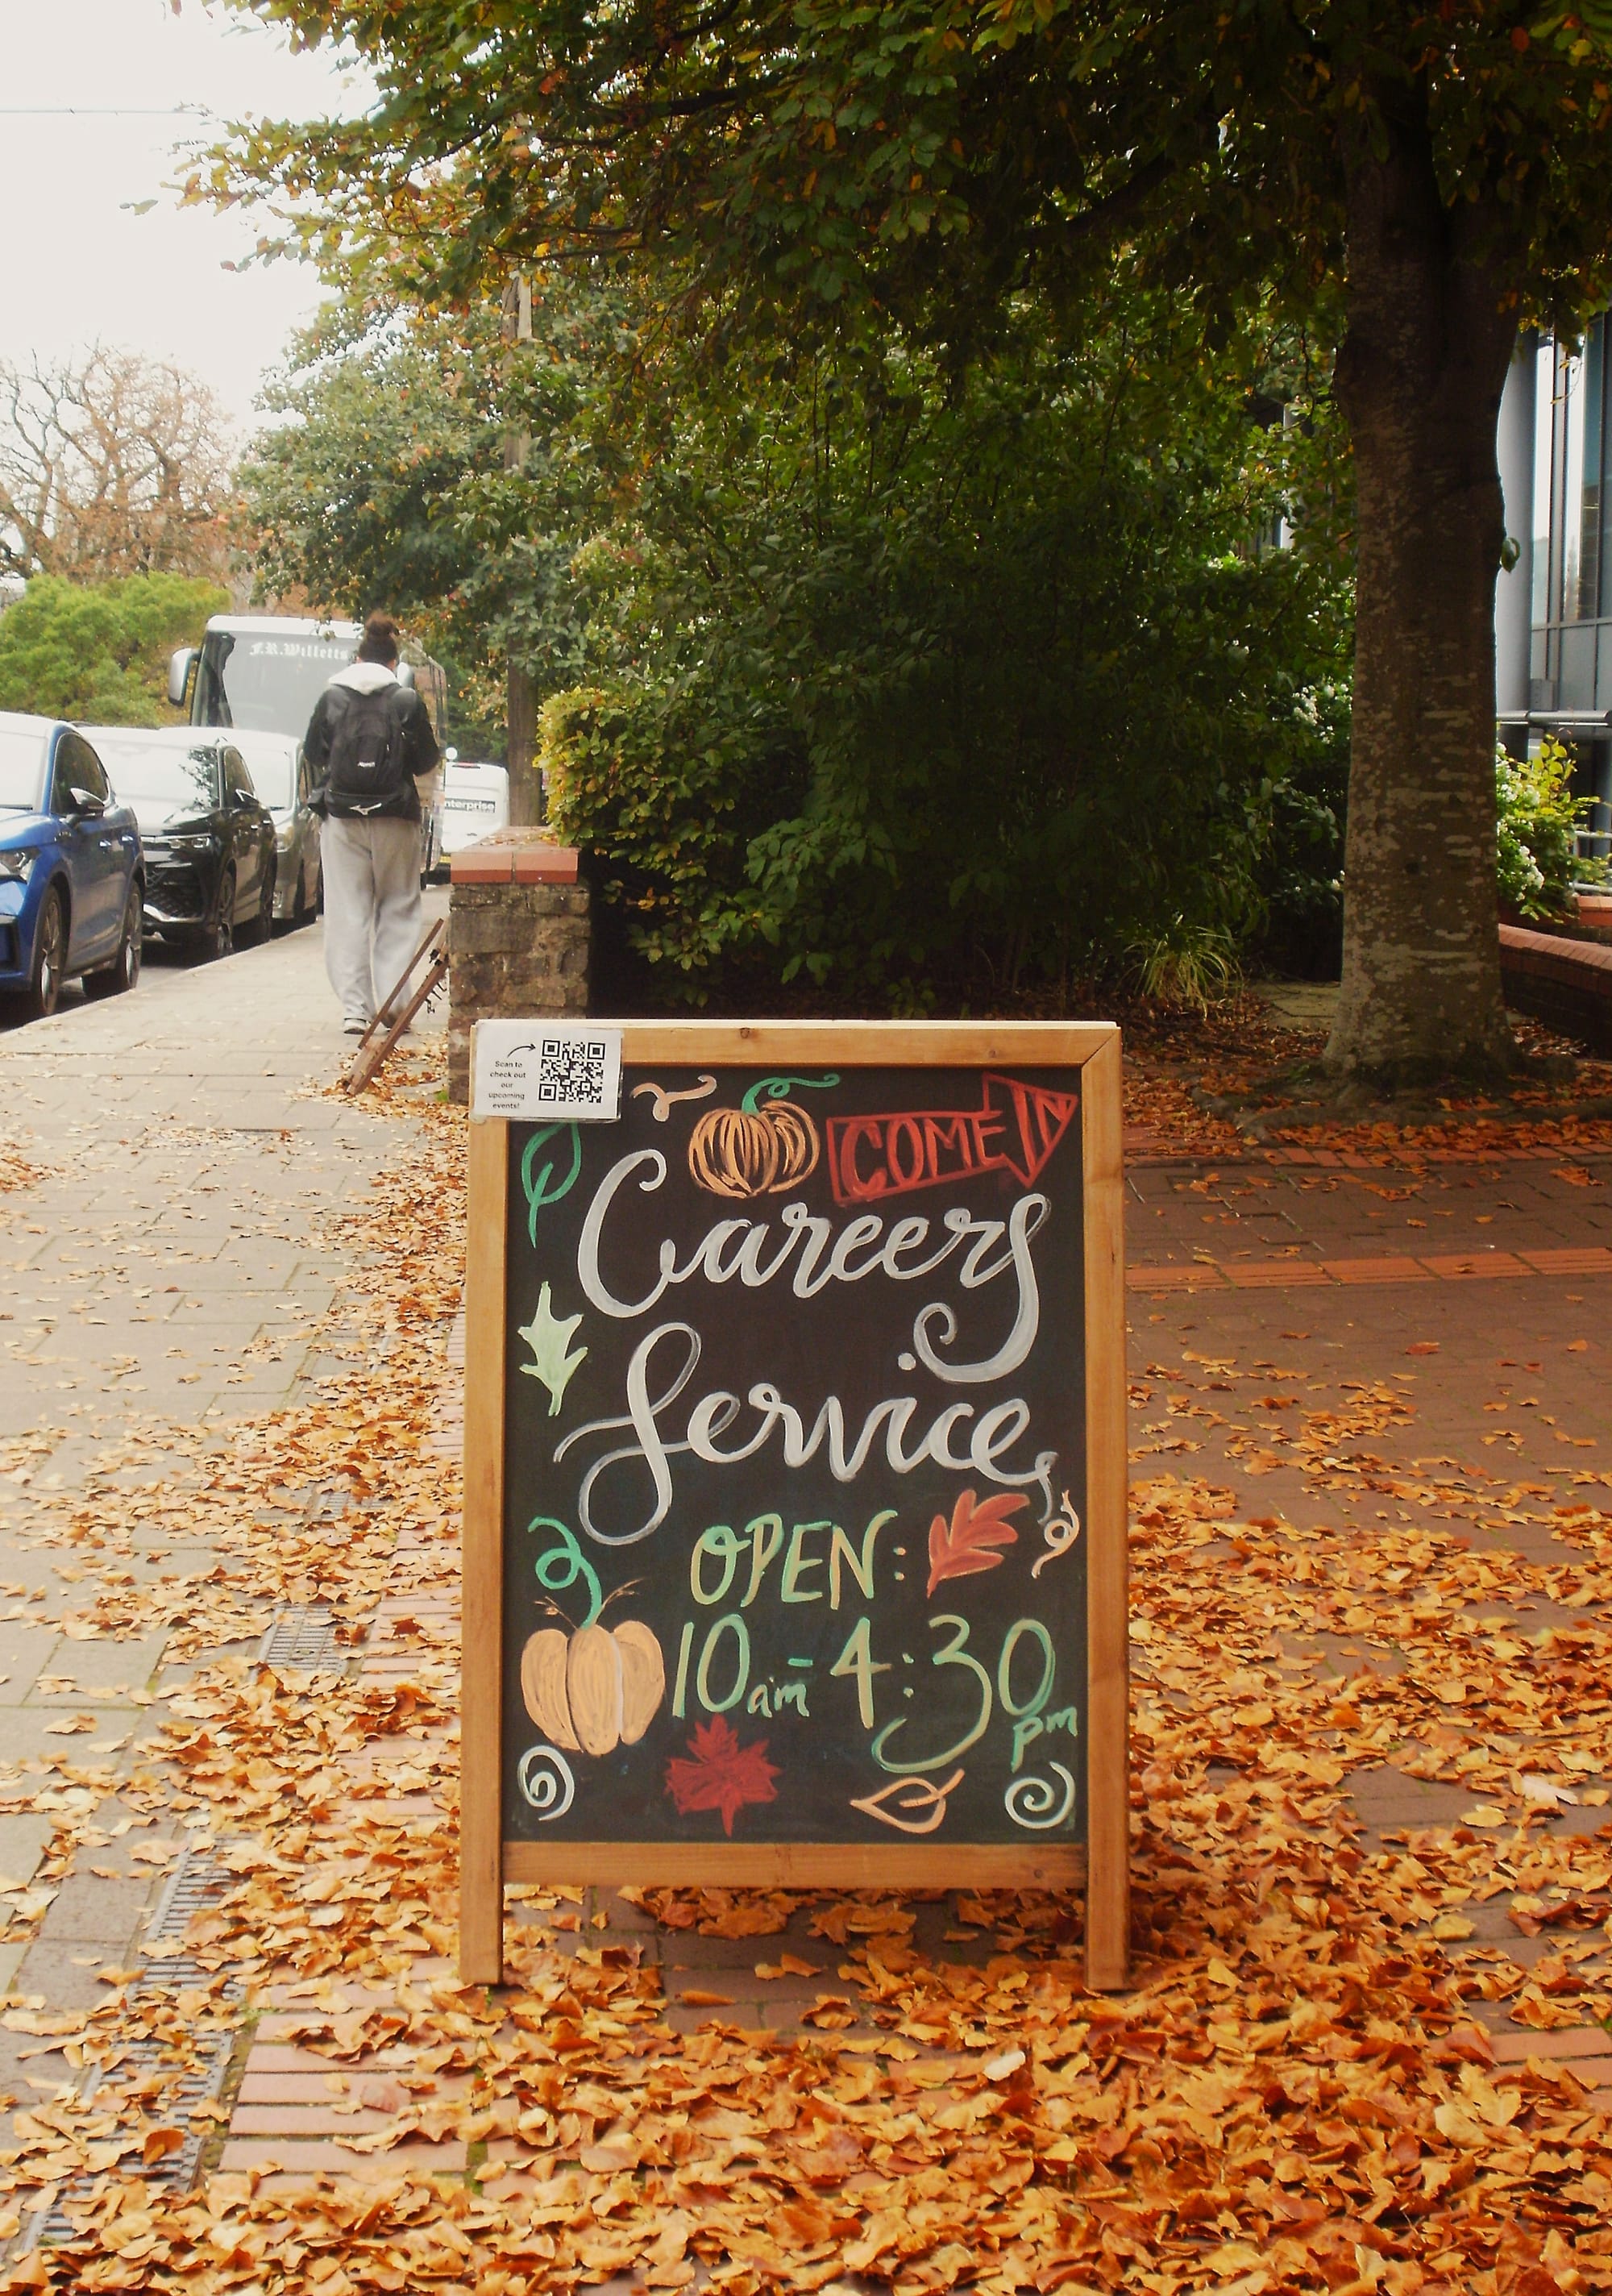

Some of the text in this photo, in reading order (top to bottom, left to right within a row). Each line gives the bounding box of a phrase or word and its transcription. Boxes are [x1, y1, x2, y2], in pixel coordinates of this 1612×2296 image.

[445, 799, 495, 811] nterprise
[840, 1084, 1071, 1196] COME IN
[579, 1149, 1051, 1383] Careers
[553, 1322, 1057, 1545] Service
